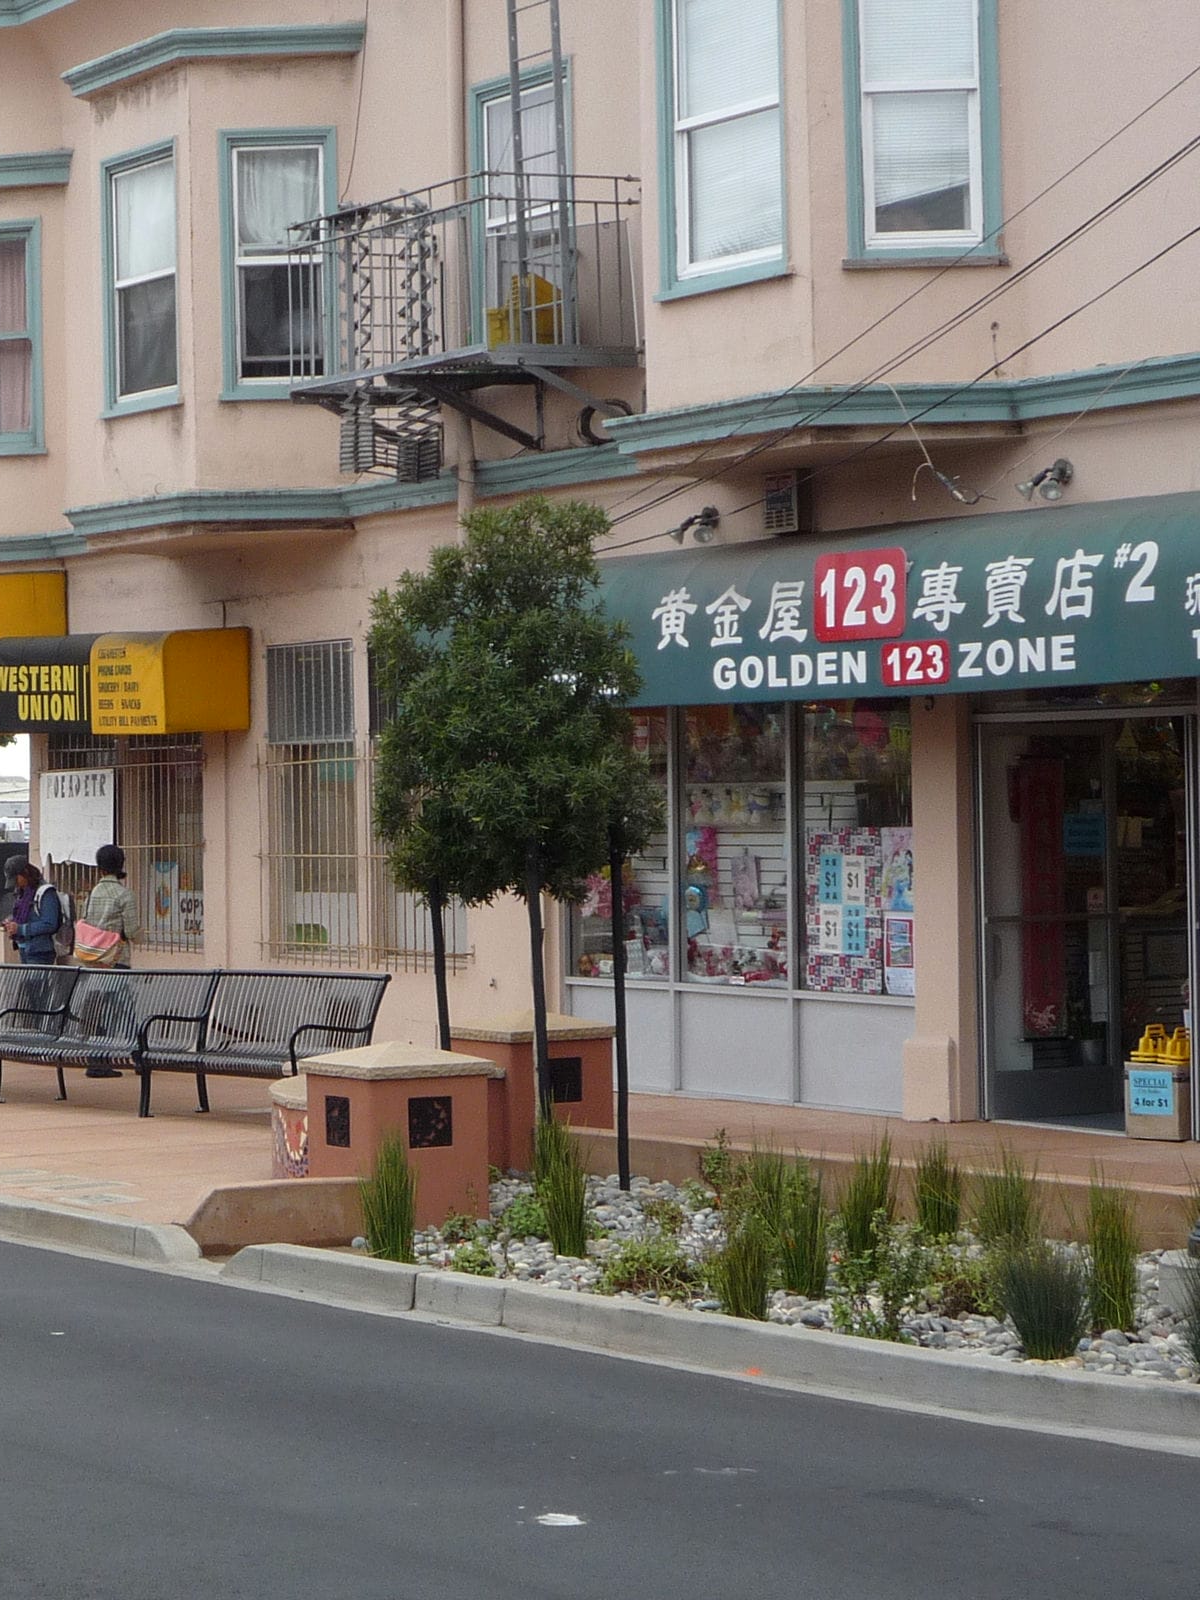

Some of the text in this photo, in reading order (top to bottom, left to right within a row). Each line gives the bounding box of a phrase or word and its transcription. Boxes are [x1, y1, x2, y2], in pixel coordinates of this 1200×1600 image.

[819, 562, 898, 629] 123
[912, 548, 1104, 632] 專賣店
[1114, 540, 1160, 603] #2
[713, 634, 1077, 690] GOLDEN 123 ZONE
[18, 694, 75, 721] UNION
[1134, 1098, 1169, 1108] 4 for $1
